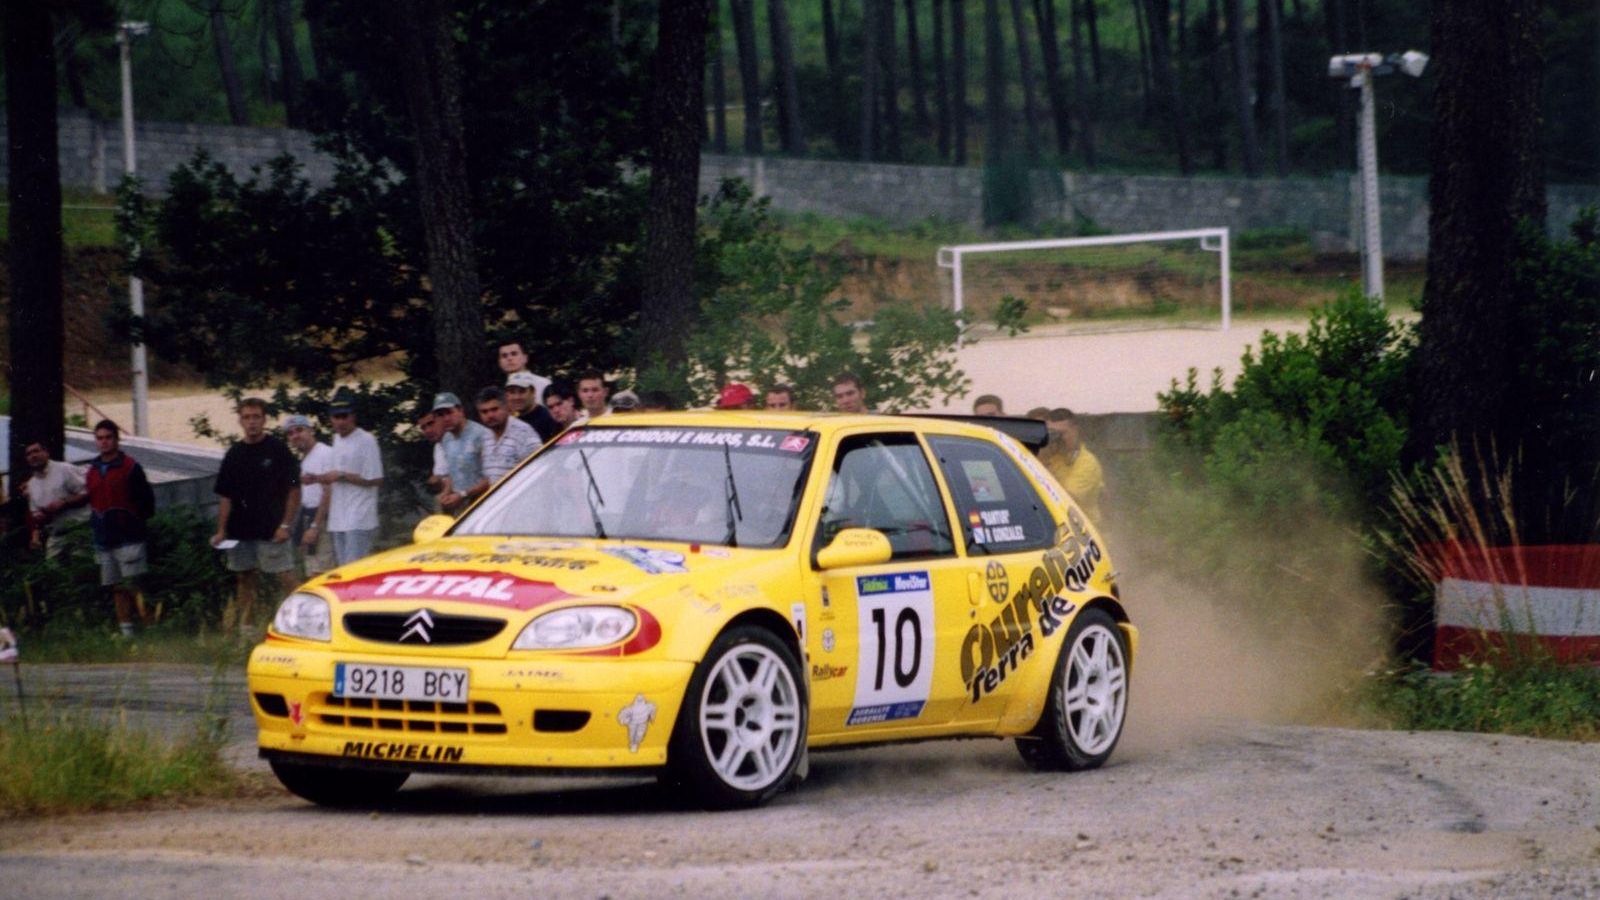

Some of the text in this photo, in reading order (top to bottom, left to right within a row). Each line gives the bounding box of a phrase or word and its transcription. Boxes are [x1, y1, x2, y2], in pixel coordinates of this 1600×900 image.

[374, 575, 515, 601] TOTAL
[961, 506, 1091, 684] Ourense
[872, 607, 922, 691] 10
[966, 539, 1101, 704] Terra de Ouro
[351, 668, 466, 697] 9218 BCY
[342, 741, 464, 761] MICHELIN
